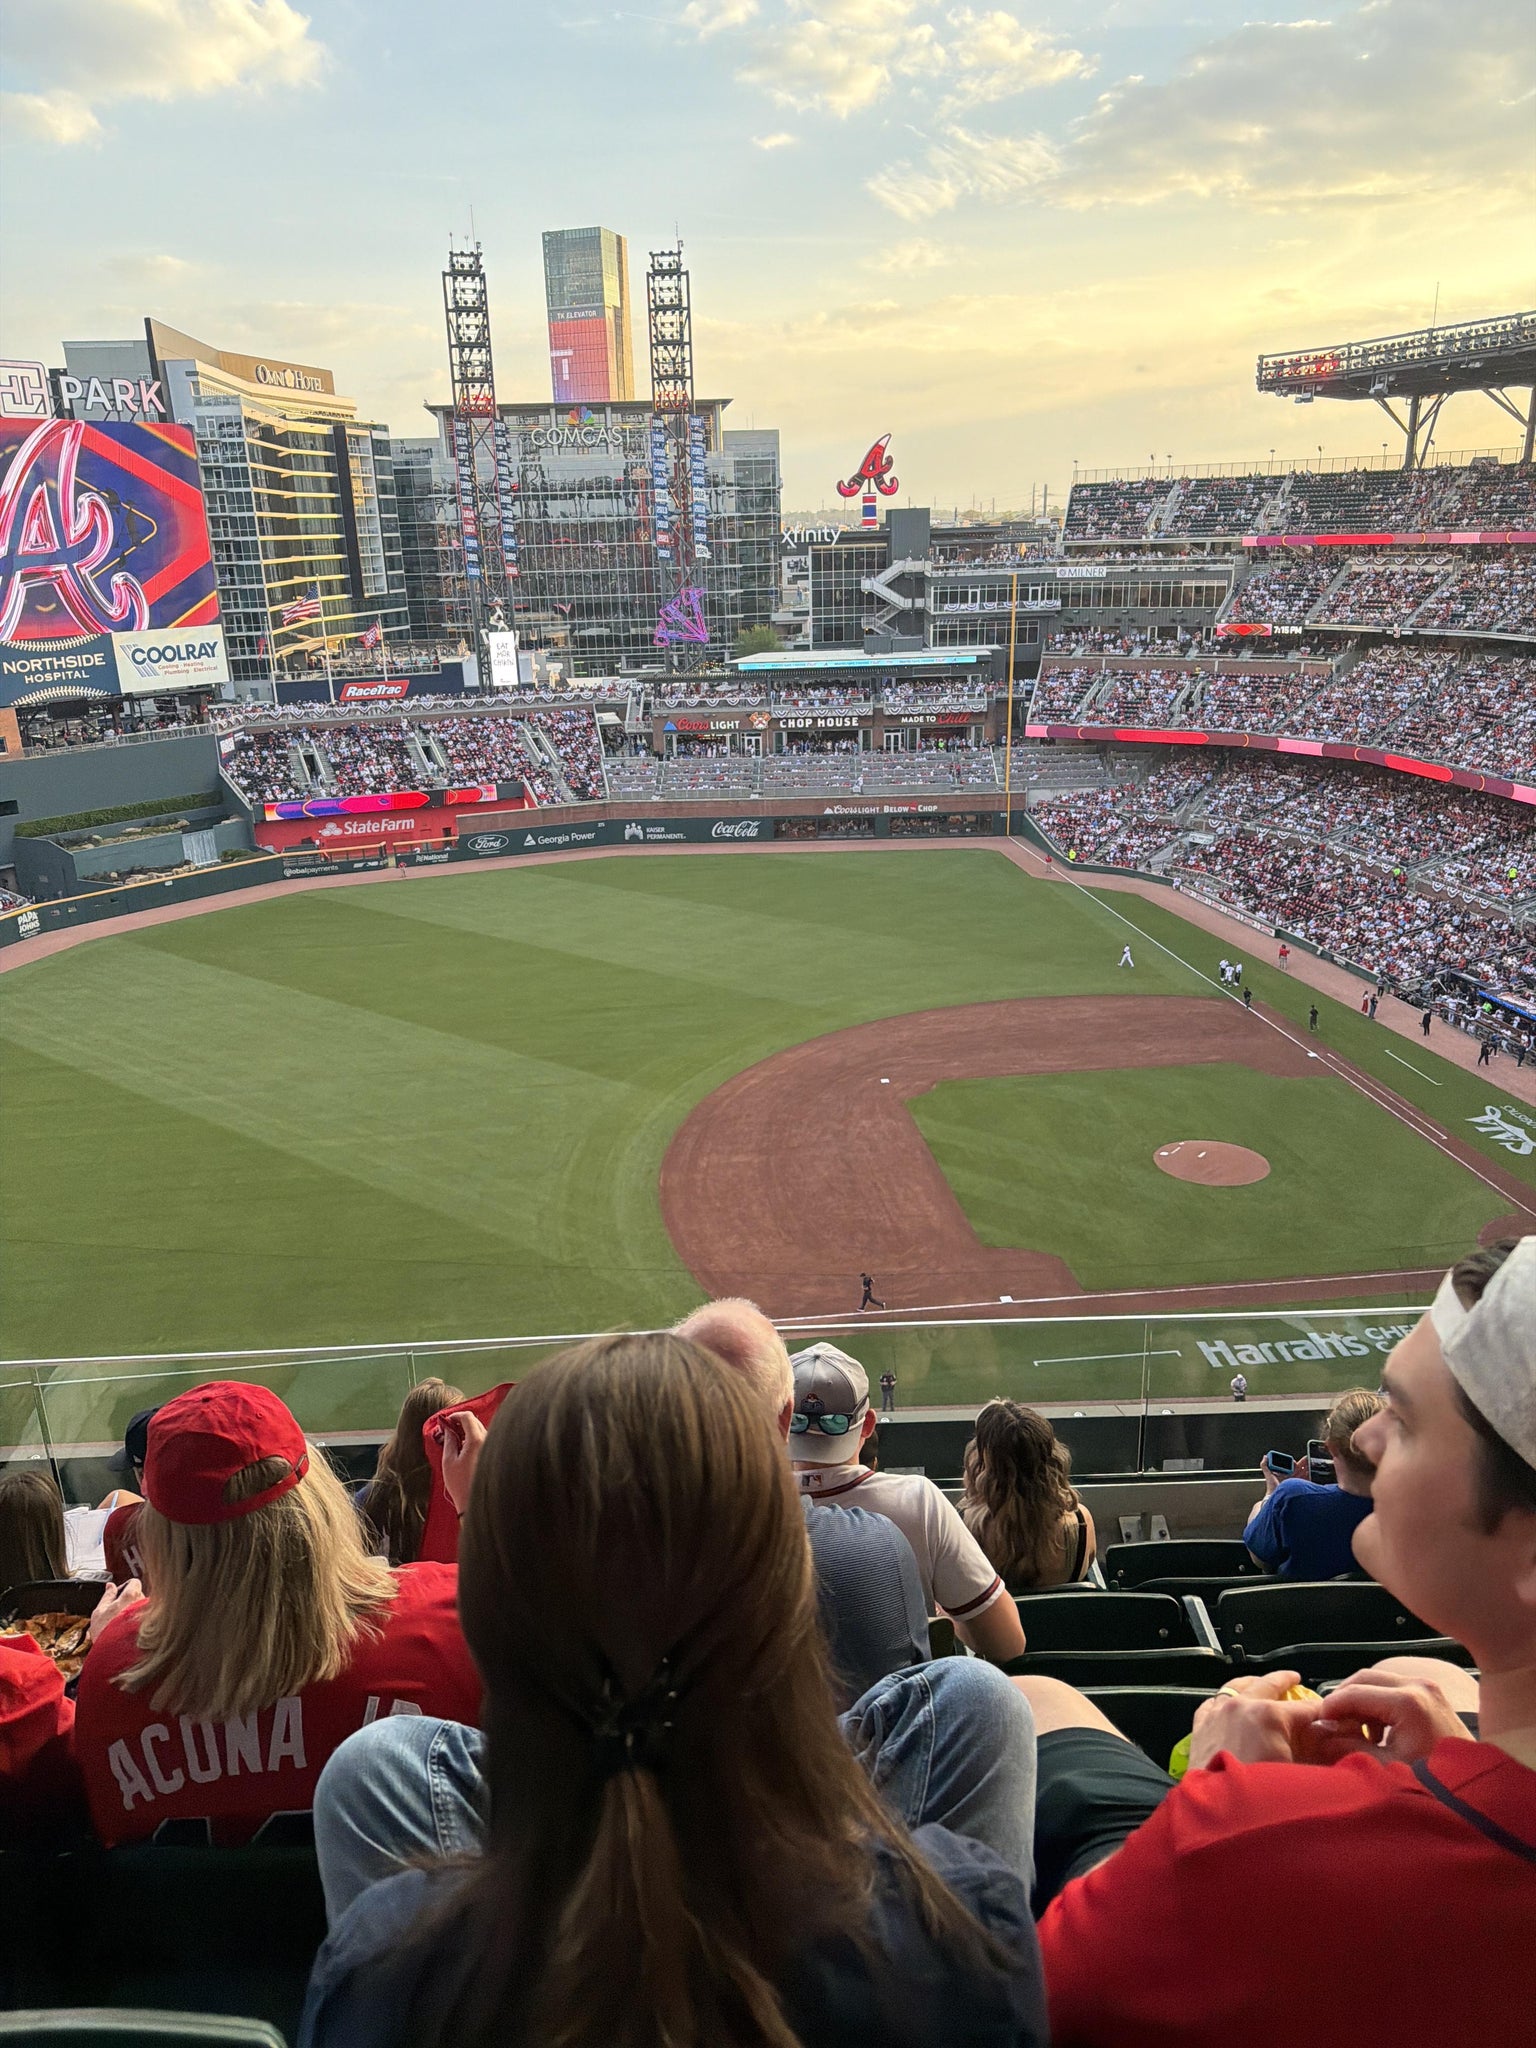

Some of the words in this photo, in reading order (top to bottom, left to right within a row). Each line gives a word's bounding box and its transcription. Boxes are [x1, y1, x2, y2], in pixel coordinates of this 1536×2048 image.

[566, 310, 597, 319] ELEVATOR
[58, 374, 167, 414] PARK
[531, 425, 633, 446] COMCAST
[781, 524, 842, 549] xfinity
[1273, 625, 1289, 635] 7:15
[1290, 625, 1303, 635] PM
[131, 641, 219, 666] COOLRAY
[2, 652, 106, 675] NORTHSIDE
[157, 662, 179, 670] Cooling
[24, 670, 90, 684] HOSPITAL
[164, 668, 190, 676] Plumbing
[193, 665, 218, 673] Electrical
[346, 684, 402, 697] RaceTrac
[676, 718, 709, 731] Coors
[710, 720, 740, 730] LIGHT
[779, 718, 812, 729] CHOP
[817, 717, 859, 728] HOUSE
[925, 715, 936, 723] TO
[858, 806, 880, 814] LIGHT
[883, 805, 909, 813] BELOW
[917, 804, 938, 812] CHOP
[711, 820, 761, 838] Coca-Cola
[475, 836, 502, 849] Ford
[538, 834, 570, 845] Georgia
[571, 831, 596, 841] Power
[423, 853, 448, 861] National
[17, 911, 39, 926] PAPA
[18, 919, 41, 934] JOHNS
